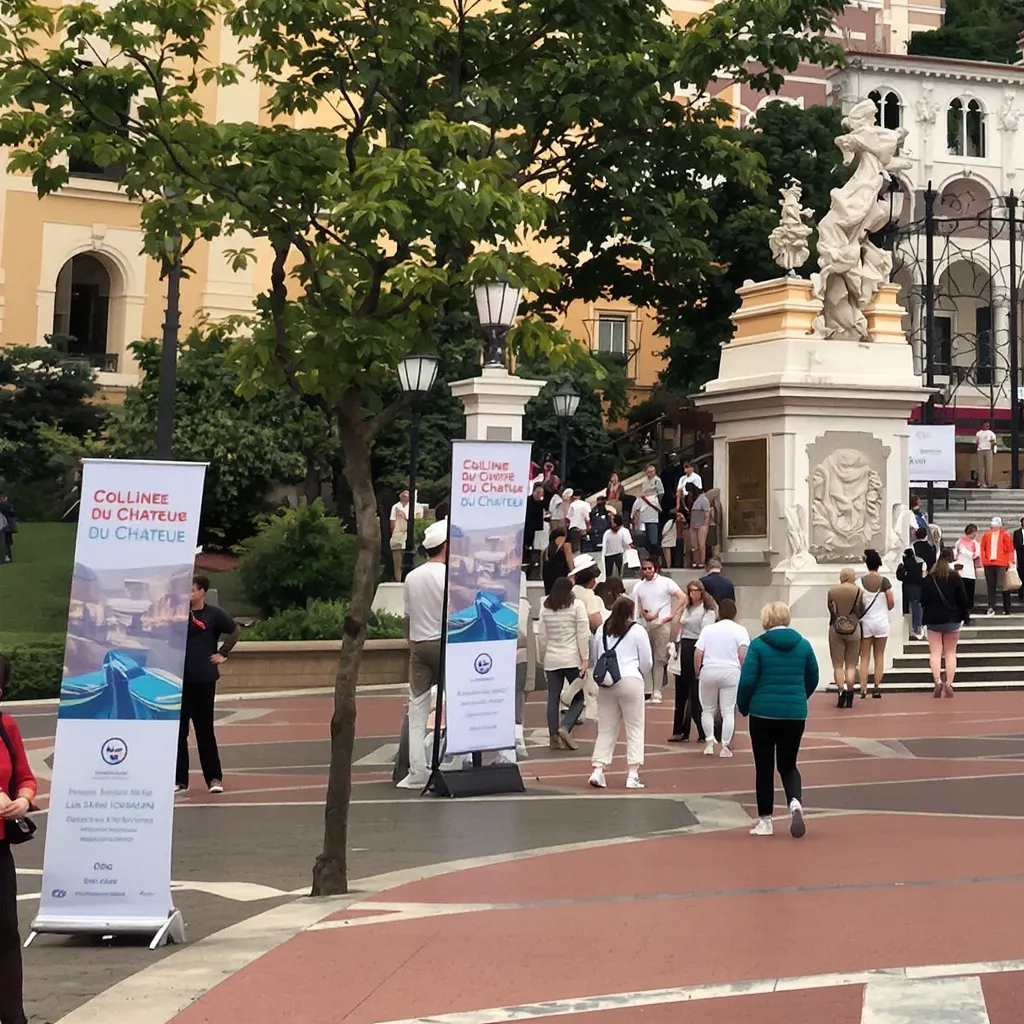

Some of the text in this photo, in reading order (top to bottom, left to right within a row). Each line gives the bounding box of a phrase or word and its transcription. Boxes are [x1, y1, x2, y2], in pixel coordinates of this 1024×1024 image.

[93, 489, 169, 505] COLLINEE
[91, 507, 112, 520] DU
[88, 525, 186, 543] DU CHATEUE
